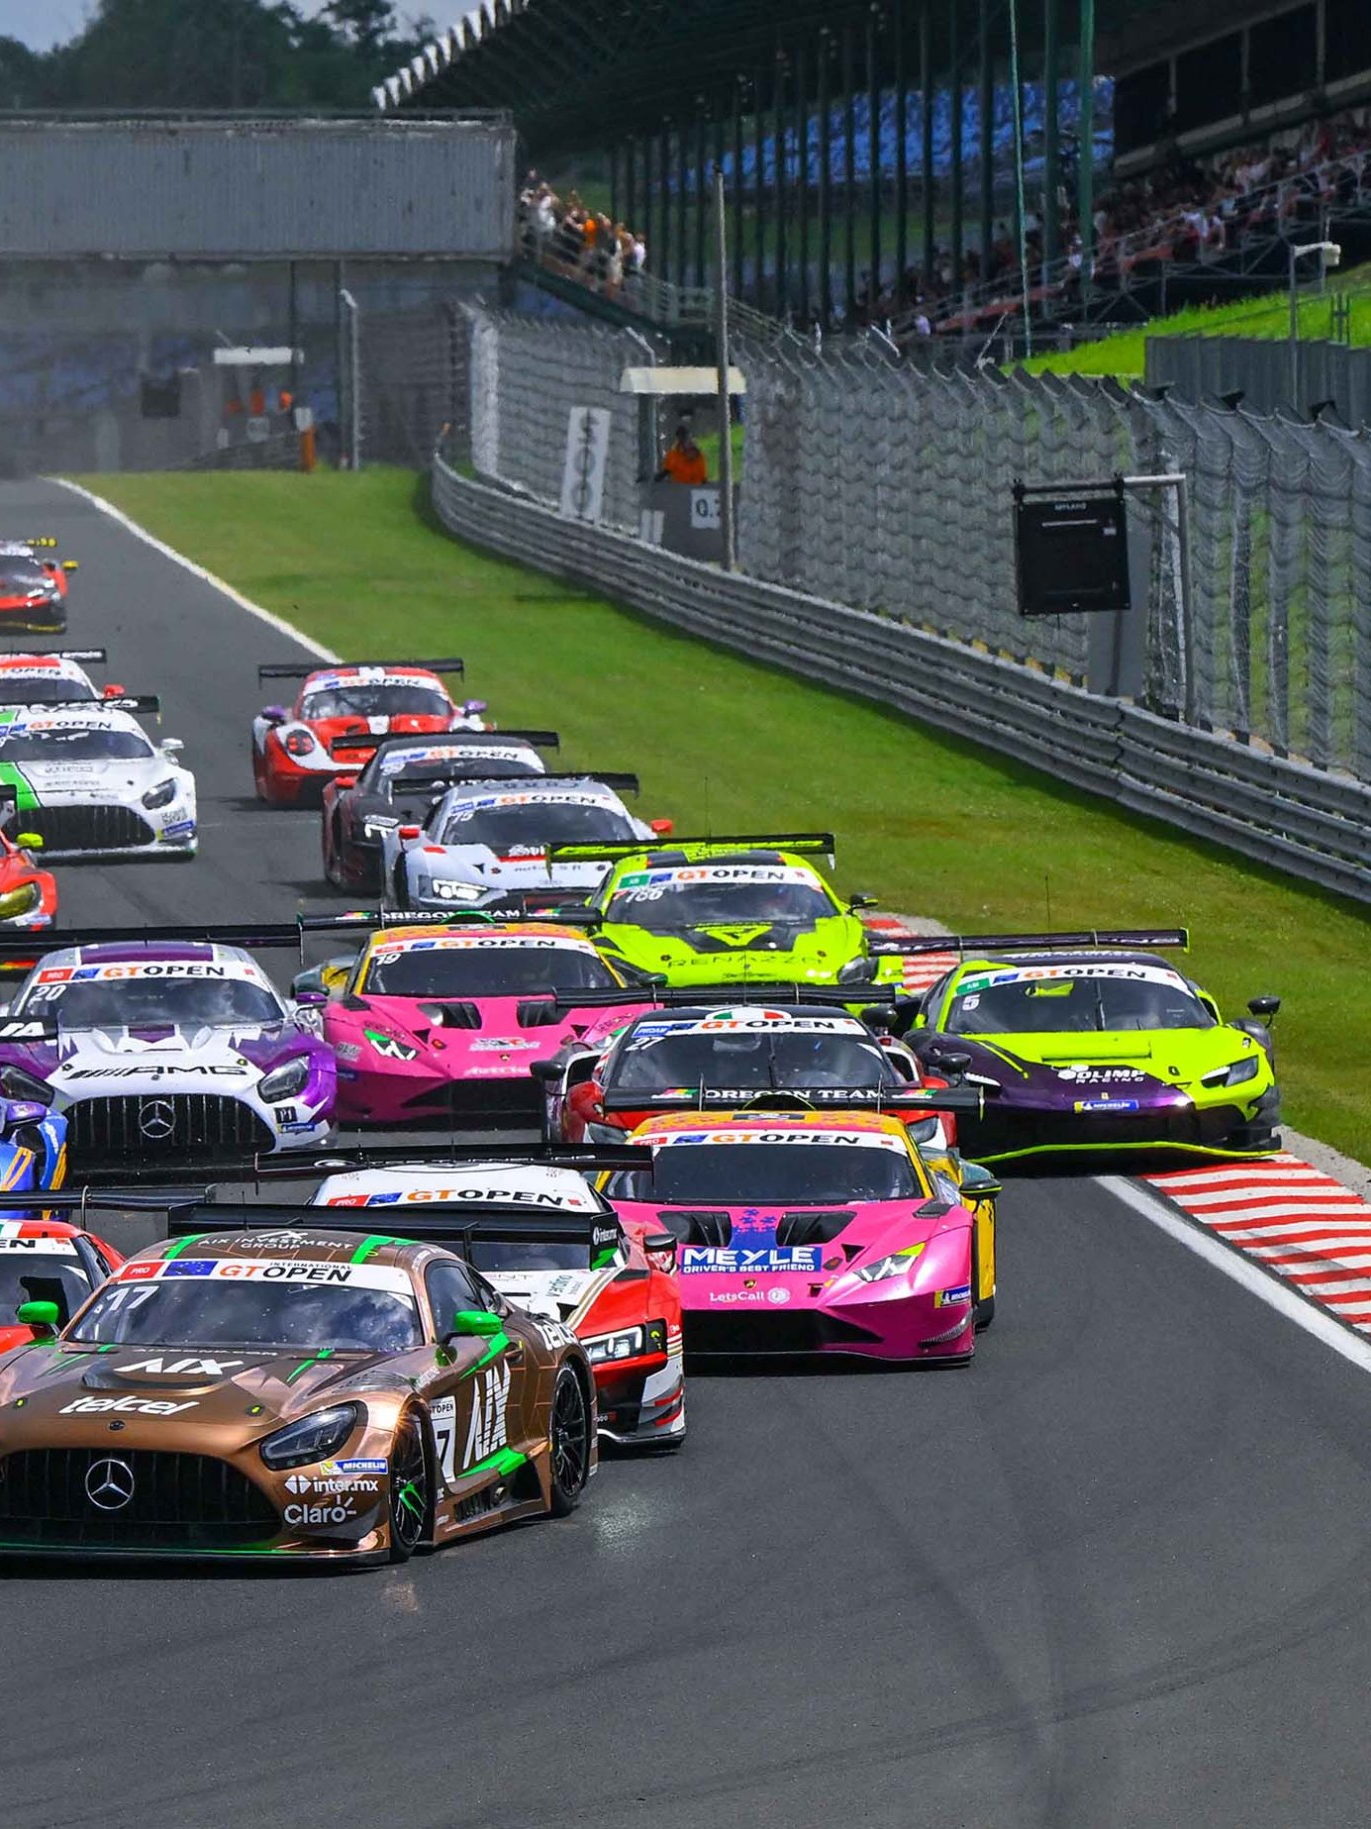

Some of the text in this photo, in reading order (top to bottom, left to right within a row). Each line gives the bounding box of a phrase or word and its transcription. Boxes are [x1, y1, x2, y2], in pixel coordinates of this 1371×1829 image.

[32, 984, 67, 1002] 20
[962, 994, 981, 1011] 5
[684, 1247, 816, 1266] MEYLE
[771, 1263, 816, 1272] FRIEND
[106, 1284, 160, 1312] 17
[58, 1396, 200, 1415] telcel
[313, 1476, 379, 1493] inter.mx
[283, 1503, 346, 1525] Claro
